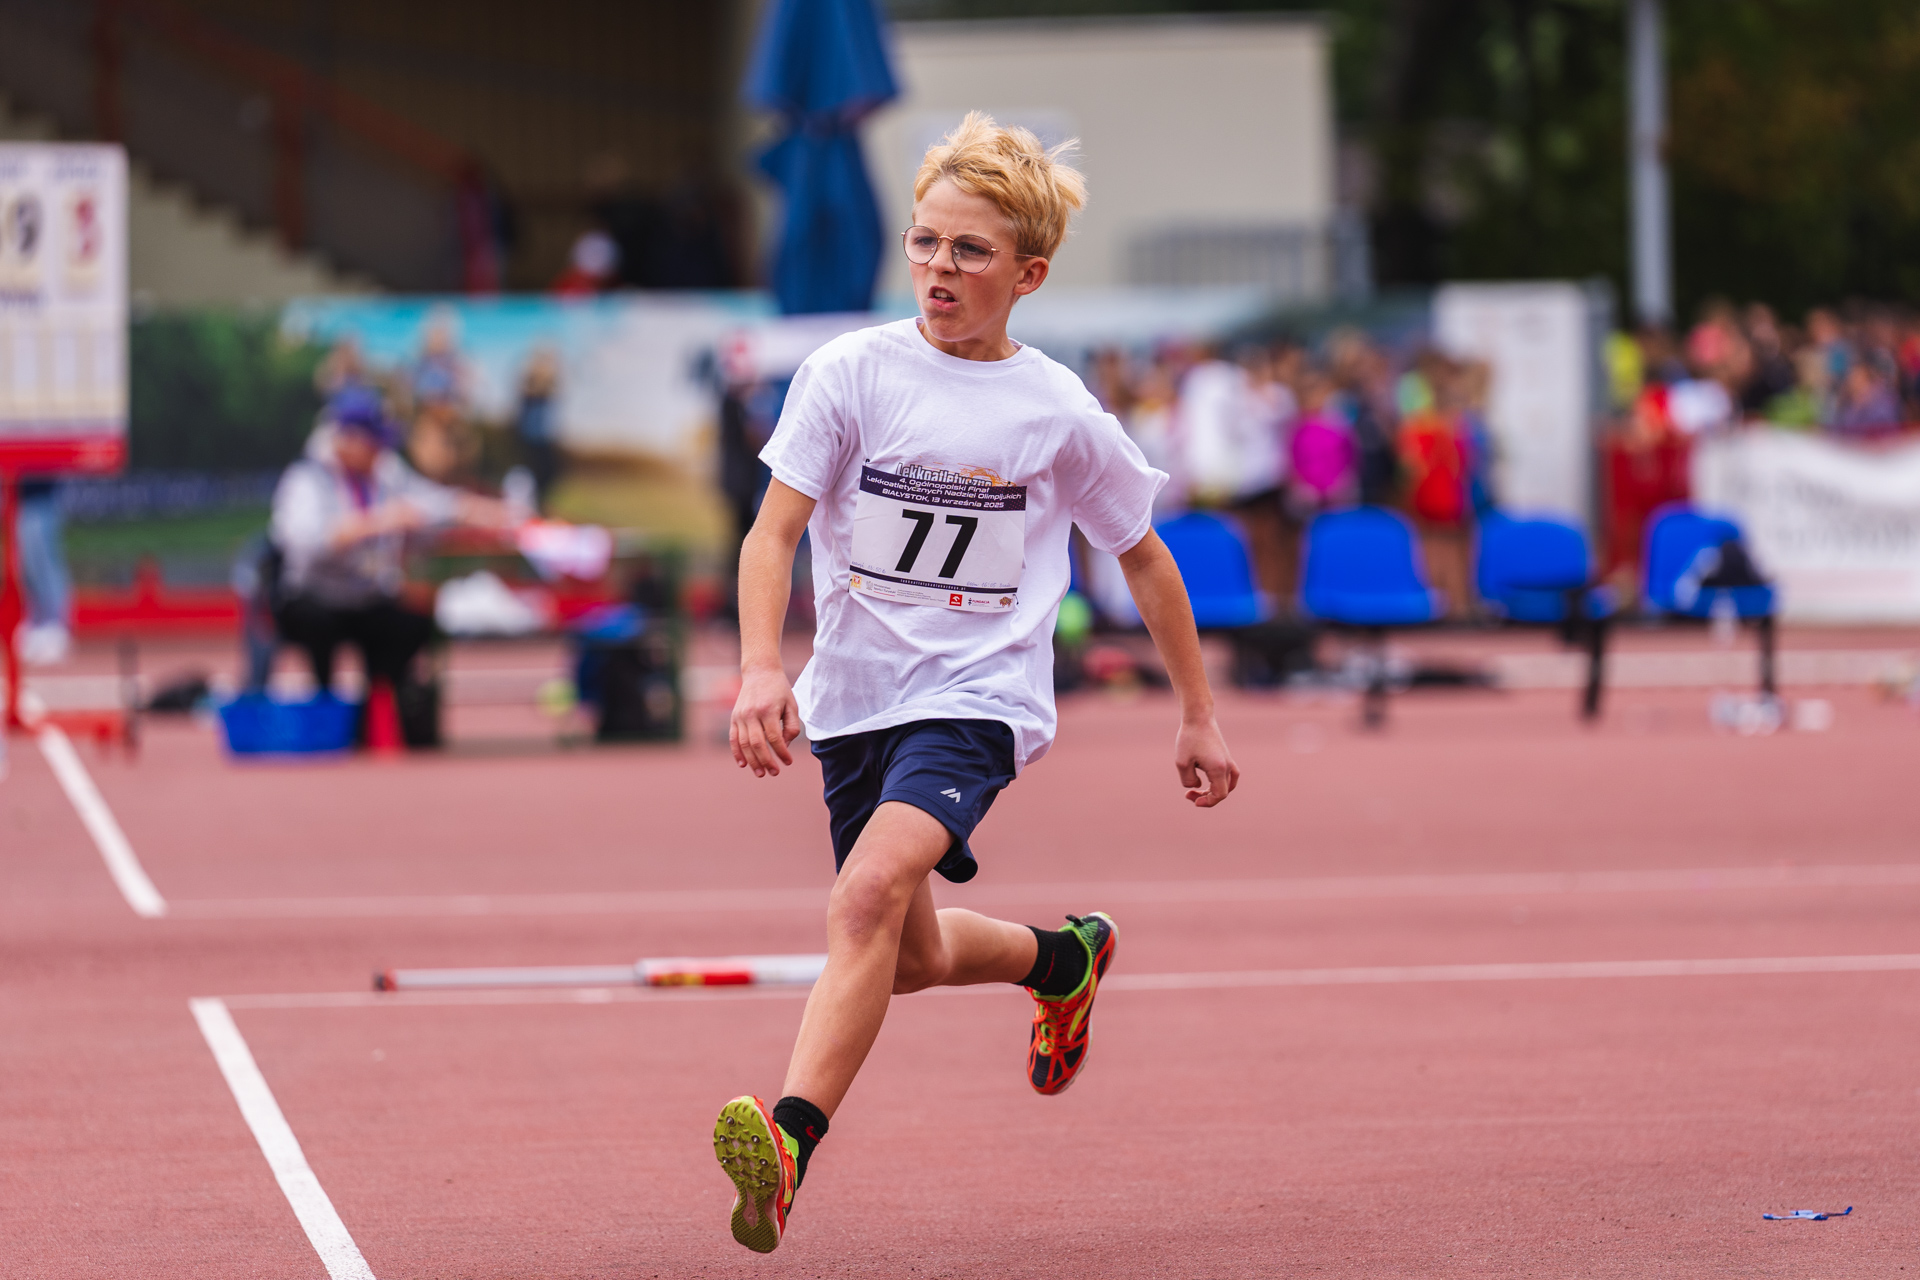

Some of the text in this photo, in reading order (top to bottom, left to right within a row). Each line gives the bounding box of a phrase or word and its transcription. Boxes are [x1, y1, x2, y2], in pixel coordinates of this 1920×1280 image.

[866, 475, 943, 495] Lekkoatletycznych
[944, 489, 976, 498] Nadziei
[909, 479, 966, 491] Ogólnopolski
[882, 488, 929, 503] BIAŁYSTOK,
[942, 498, 982, 508] września
[894, 508, 979, 579] 77
